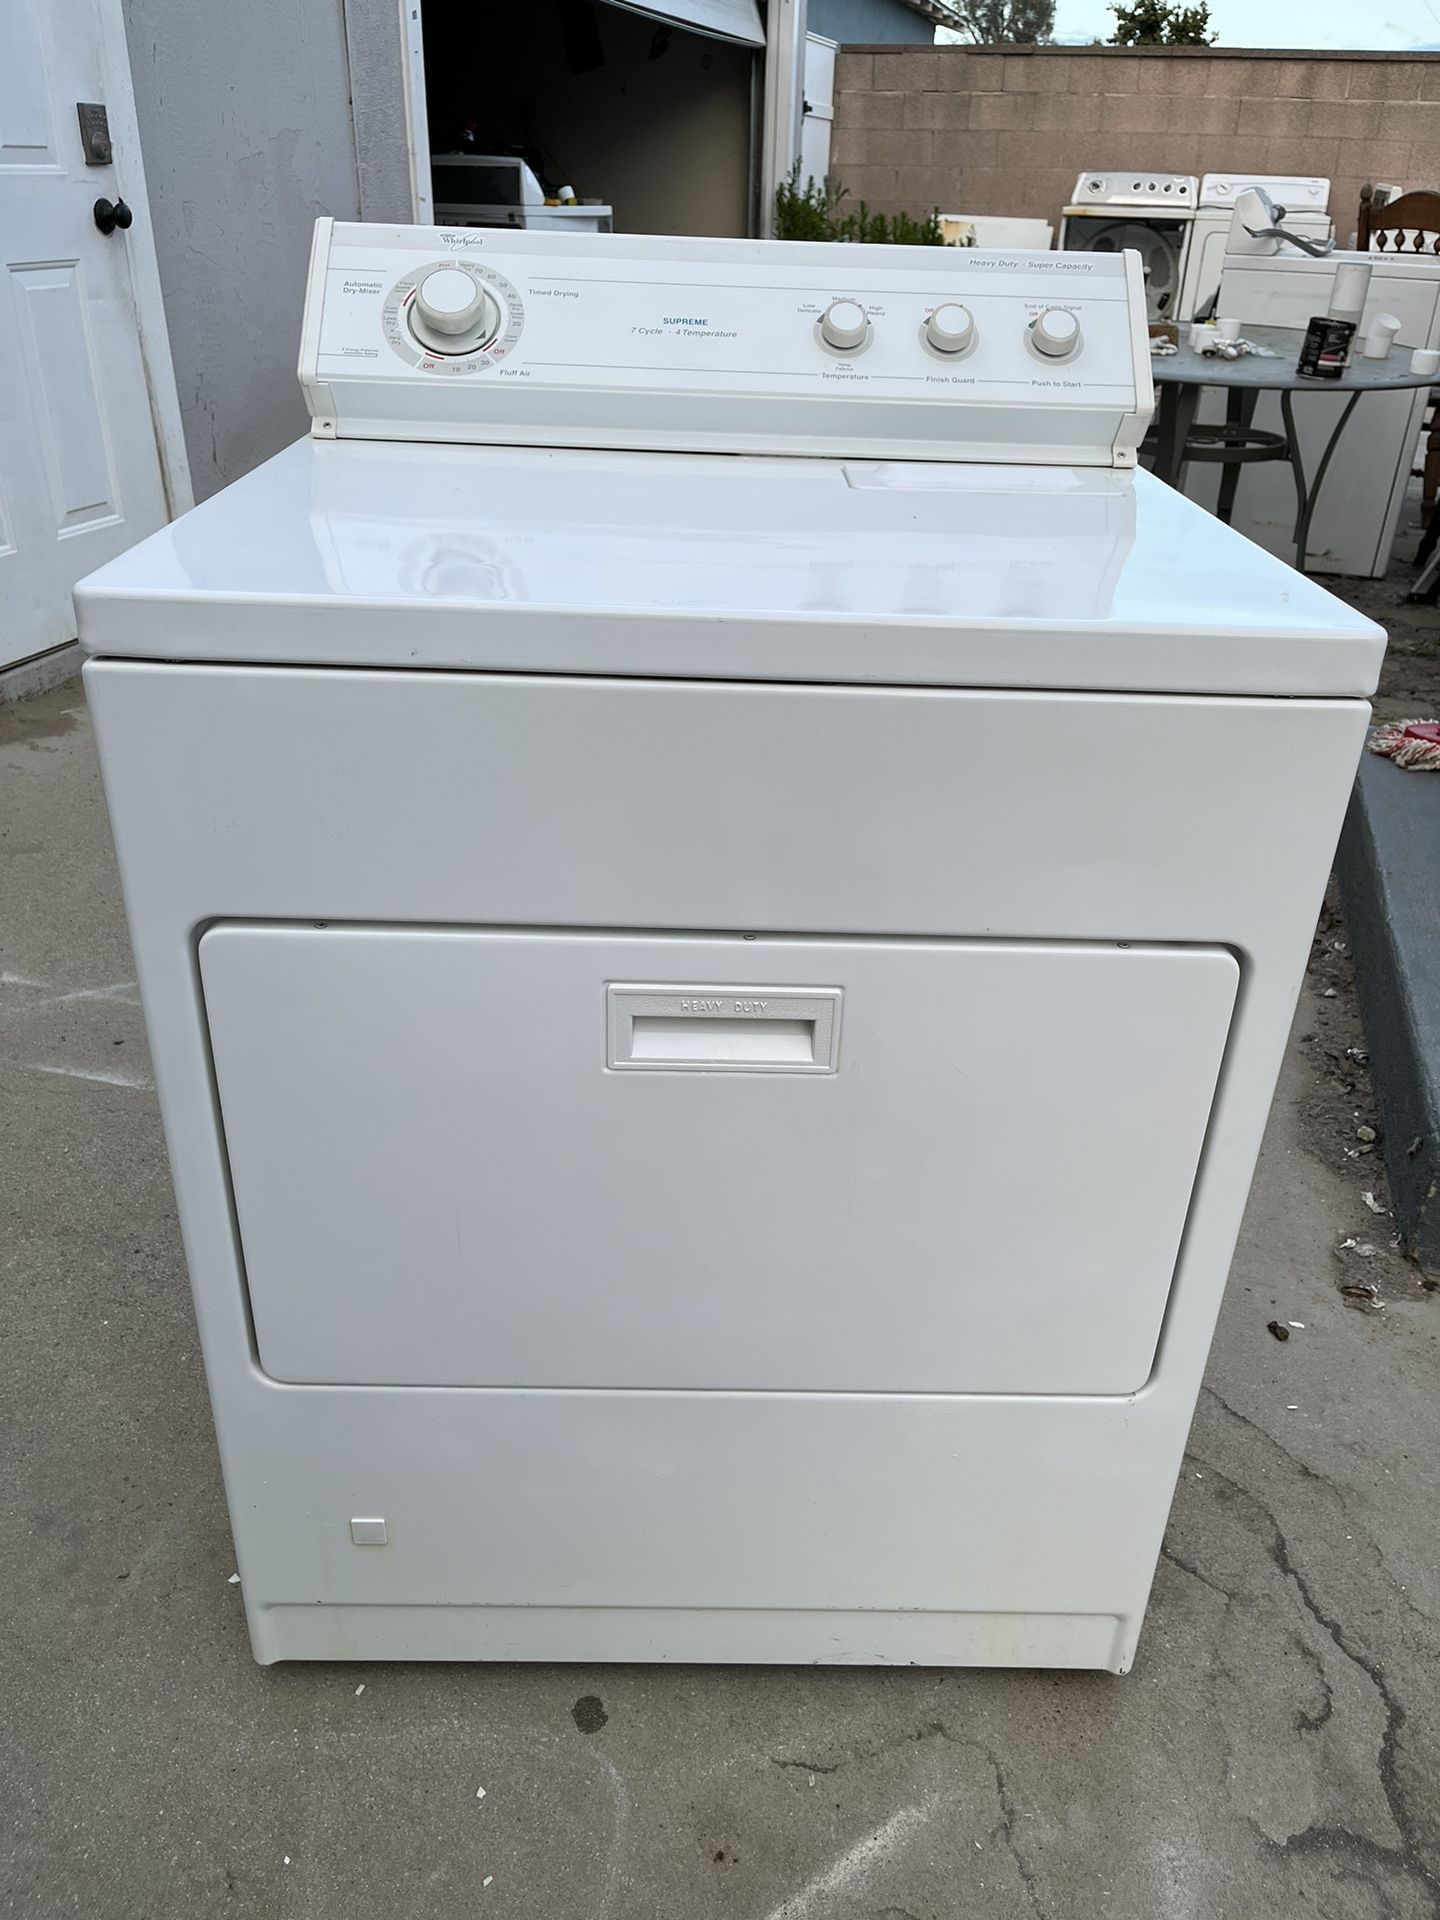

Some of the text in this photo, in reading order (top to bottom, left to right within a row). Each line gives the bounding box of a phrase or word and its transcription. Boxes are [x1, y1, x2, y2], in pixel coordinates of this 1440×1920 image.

[442, 236, 483, 247] Whirlpool
[969, 259, 1093, 271] Heavy Duty Super Capacity
[343, 287, 380, 295] Dry-Miser
[553, 290, 579, 298] Drying
[663, 317, 708, 325] SUPREME
[638, 327, 663, 335] Cycle
[683, 329, 737, 338] Temperature
[821, 372, 869, 380] Temperature
[680, 1000, 768, 1013] HEAVY DUTY
